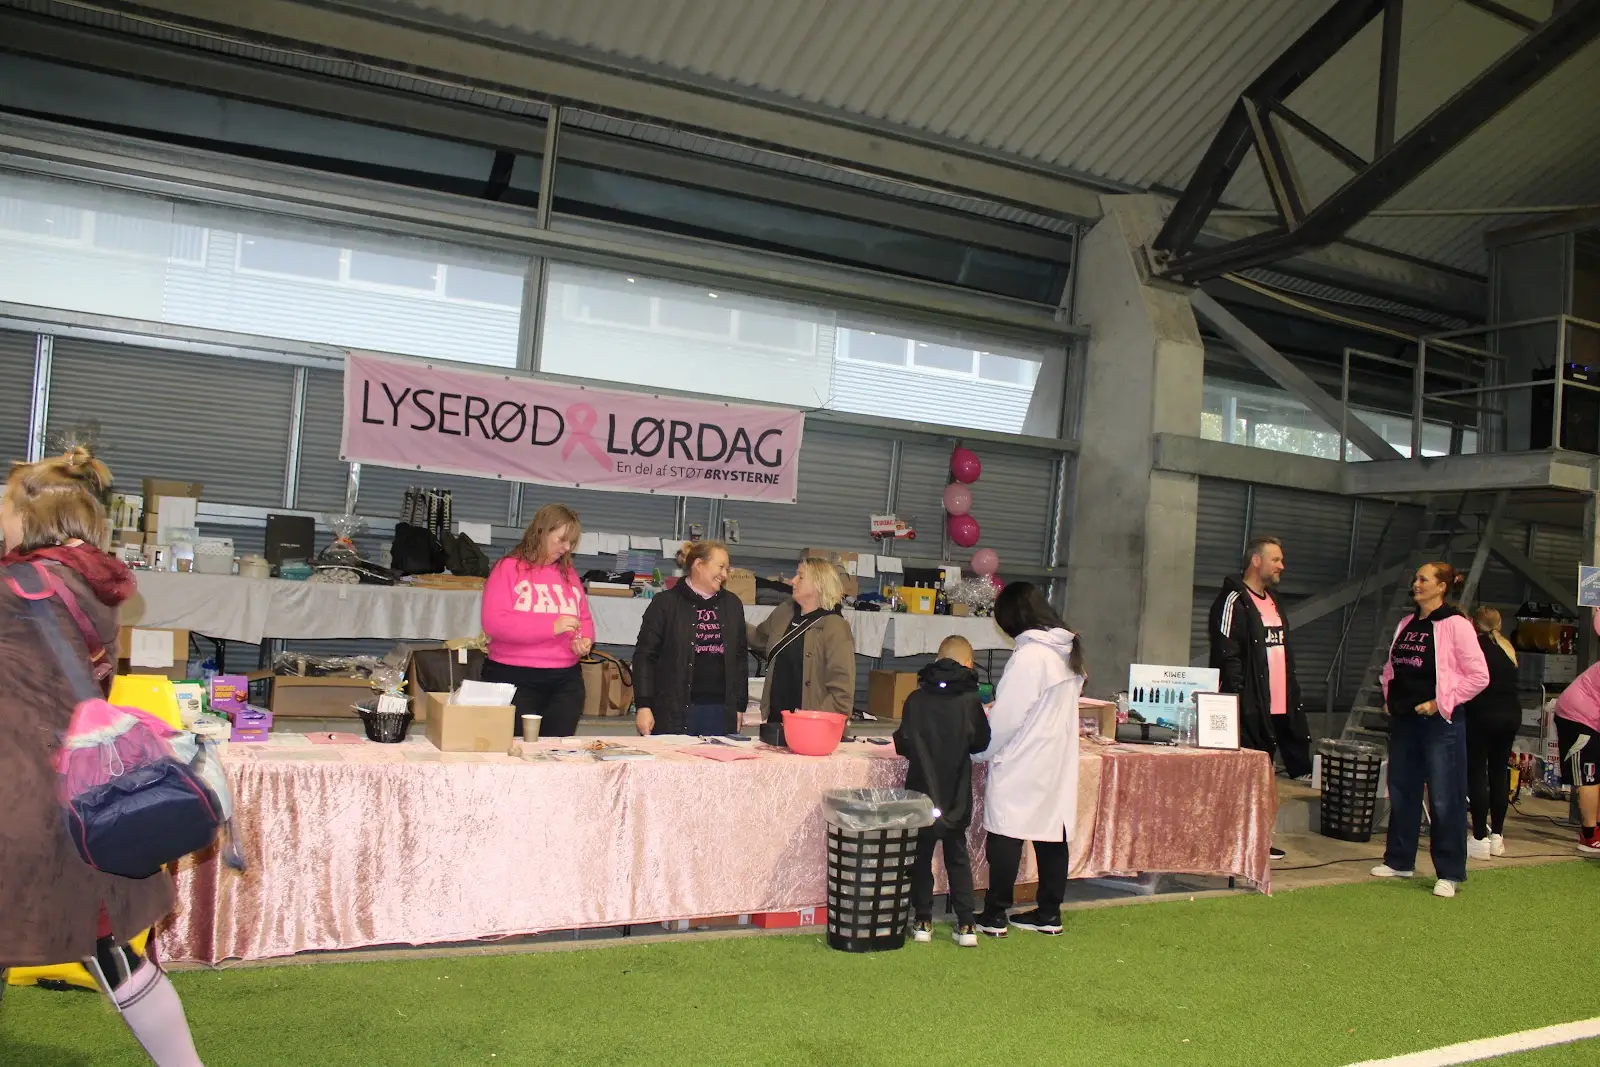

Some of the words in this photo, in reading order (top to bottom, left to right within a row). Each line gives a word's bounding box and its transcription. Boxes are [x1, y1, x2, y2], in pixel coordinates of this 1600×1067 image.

[362, 379, 565, 446] LYSERØD
[606, 413, 783, 468] LØRDAG
[616, 461, 632, 473] En
[635, 462, 653, 475] del
[655, 464, 668, 477] af
[1163, 670, 1187, 679] KIWEE
